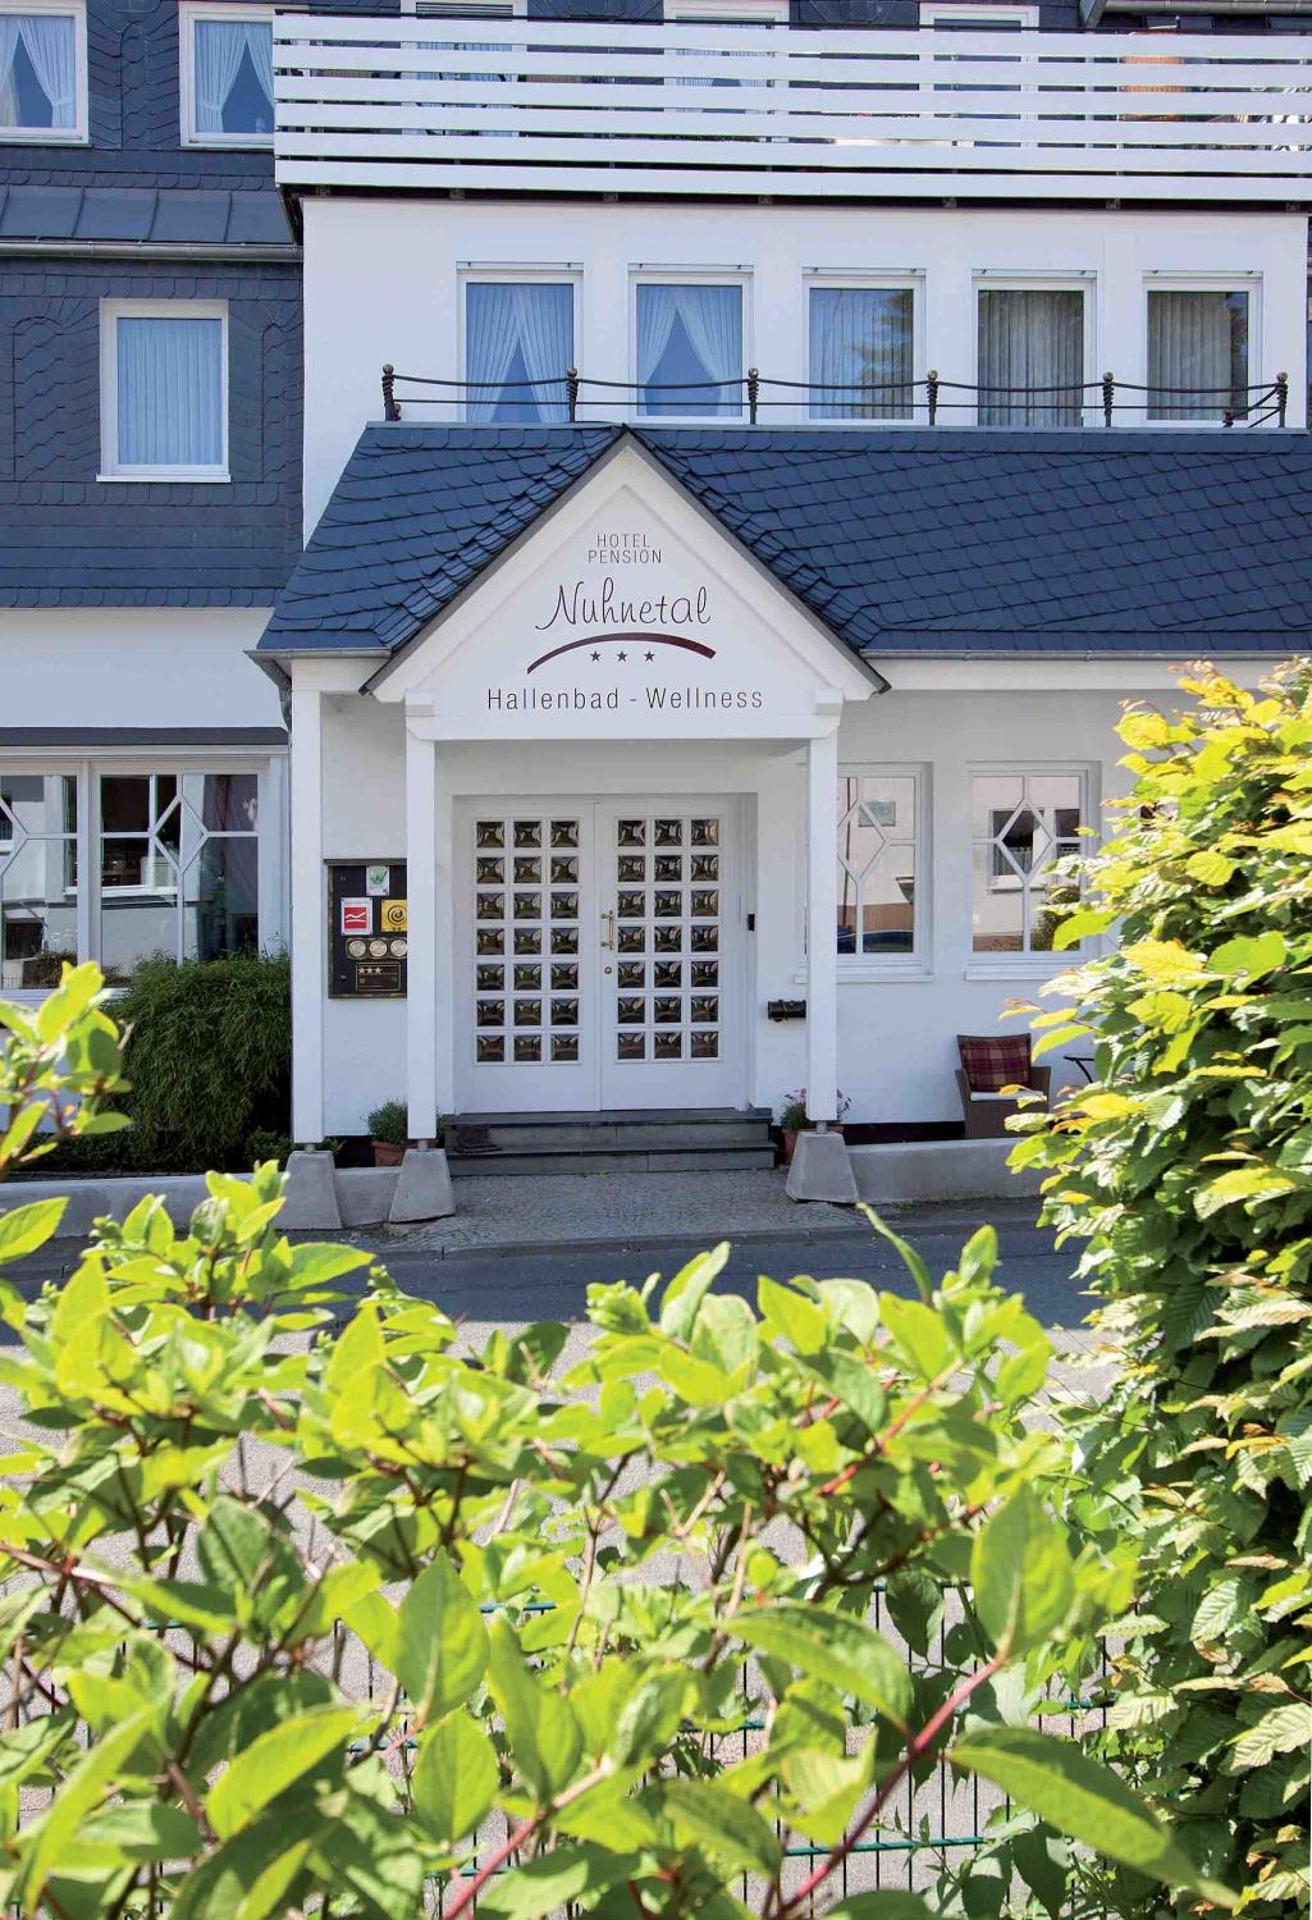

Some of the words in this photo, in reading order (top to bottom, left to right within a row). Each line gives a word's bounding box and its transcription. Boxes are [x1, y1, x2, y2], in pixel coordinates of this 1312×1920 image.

[597, 533, 650, 548] HOTEL
[588, 550, 662, 564] PENSION
[535, 577, 711, 630] Nuhnetal
[488, 687, 618, 709] Hallenbad
[646, 687, 763, 709] Wellness
